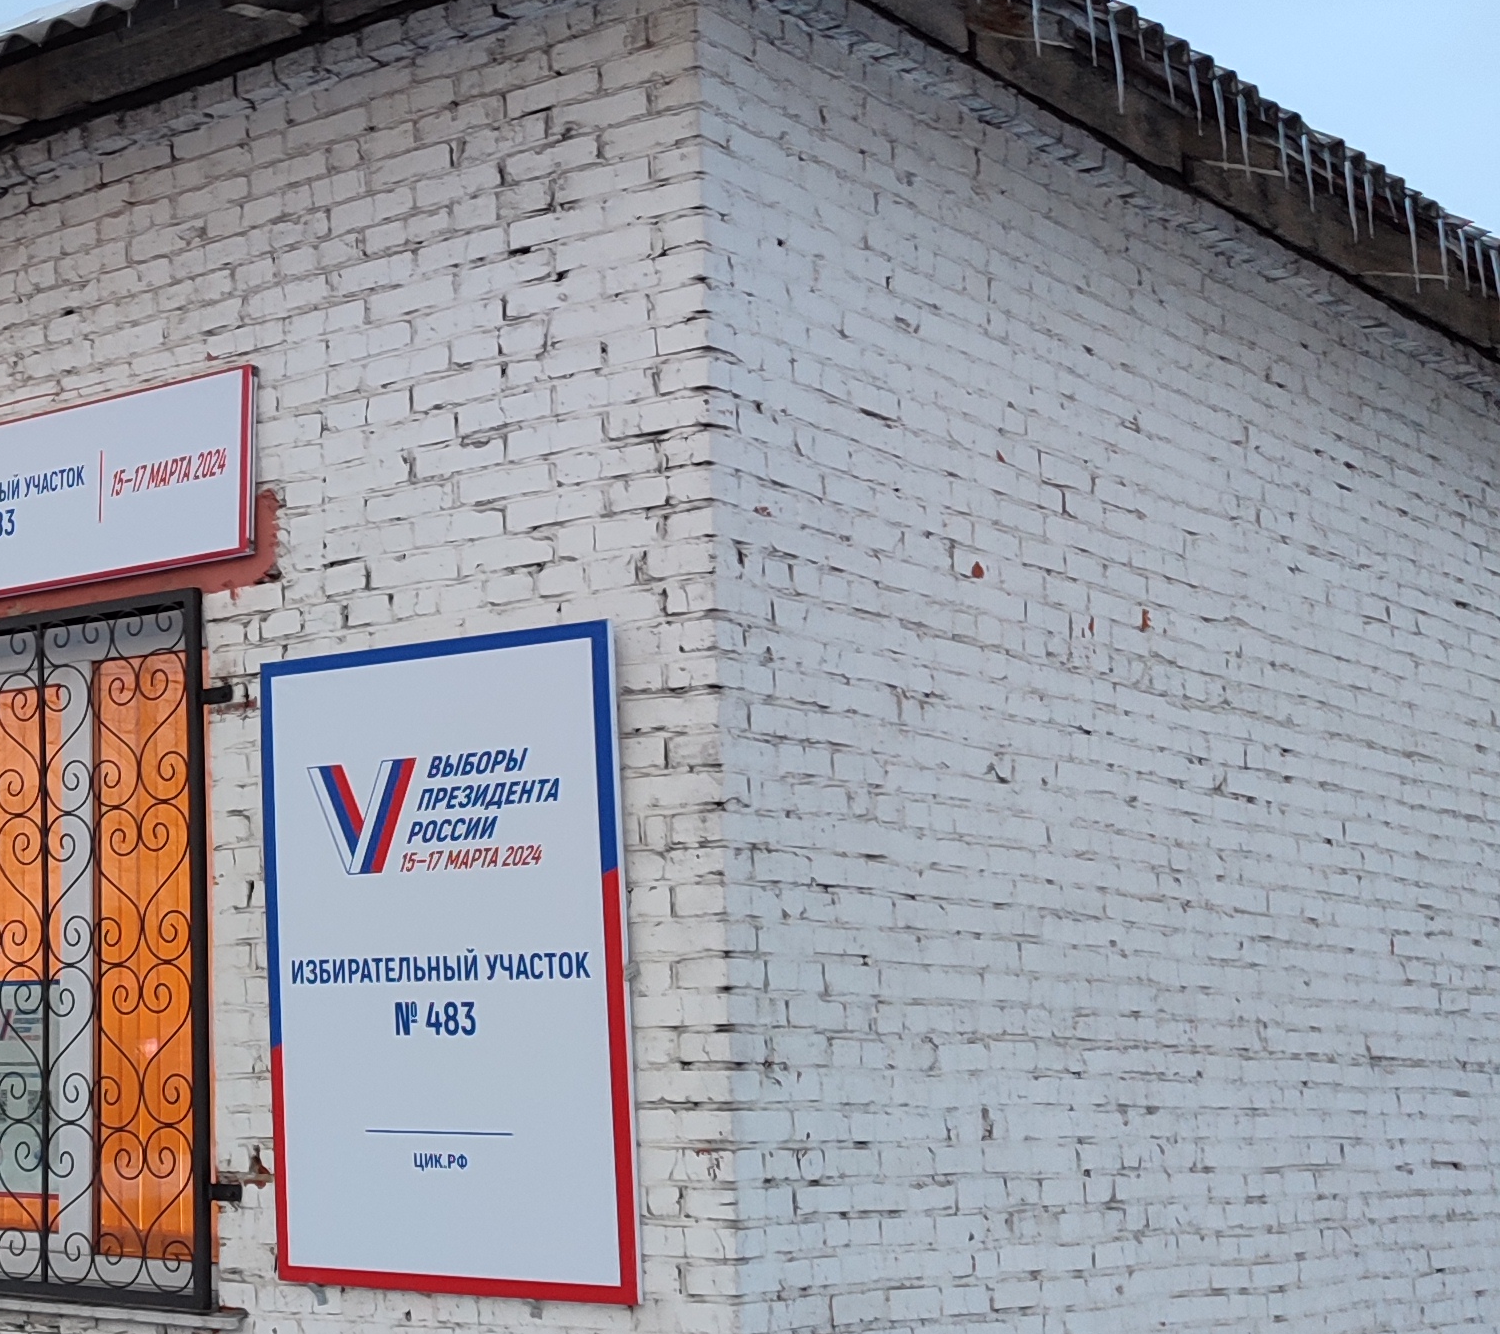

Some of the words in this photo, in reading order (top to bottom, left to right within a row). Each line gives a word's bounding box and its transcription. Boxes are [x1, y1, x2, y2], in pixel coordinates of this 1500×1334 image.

[14, 464, 85, 498] УЧАСТОК
[146, 453, 191, 490] МАРТА
[192, 447, 227, 481] 2024
[426, 747, 529, 779] ВЫБОРЫ
[416, 777, 560, 812] ПРЕЗИДЕНТА
[406, 815, 499, 845] РОССИИ
[444, 845, 500, 871] МАРТА
[501, 843, 543, 868] 2024
[291, 948, 479, 985] ИЗБИРАТЕЛЬНЫЙ
[485, 951, 591, 981] УЧАСТОК
[394, 1001, 418, 1036] №
[425, 1001, 476, 1036] 483
[413, 1152, 468, 1171] ЦИК.РФ
